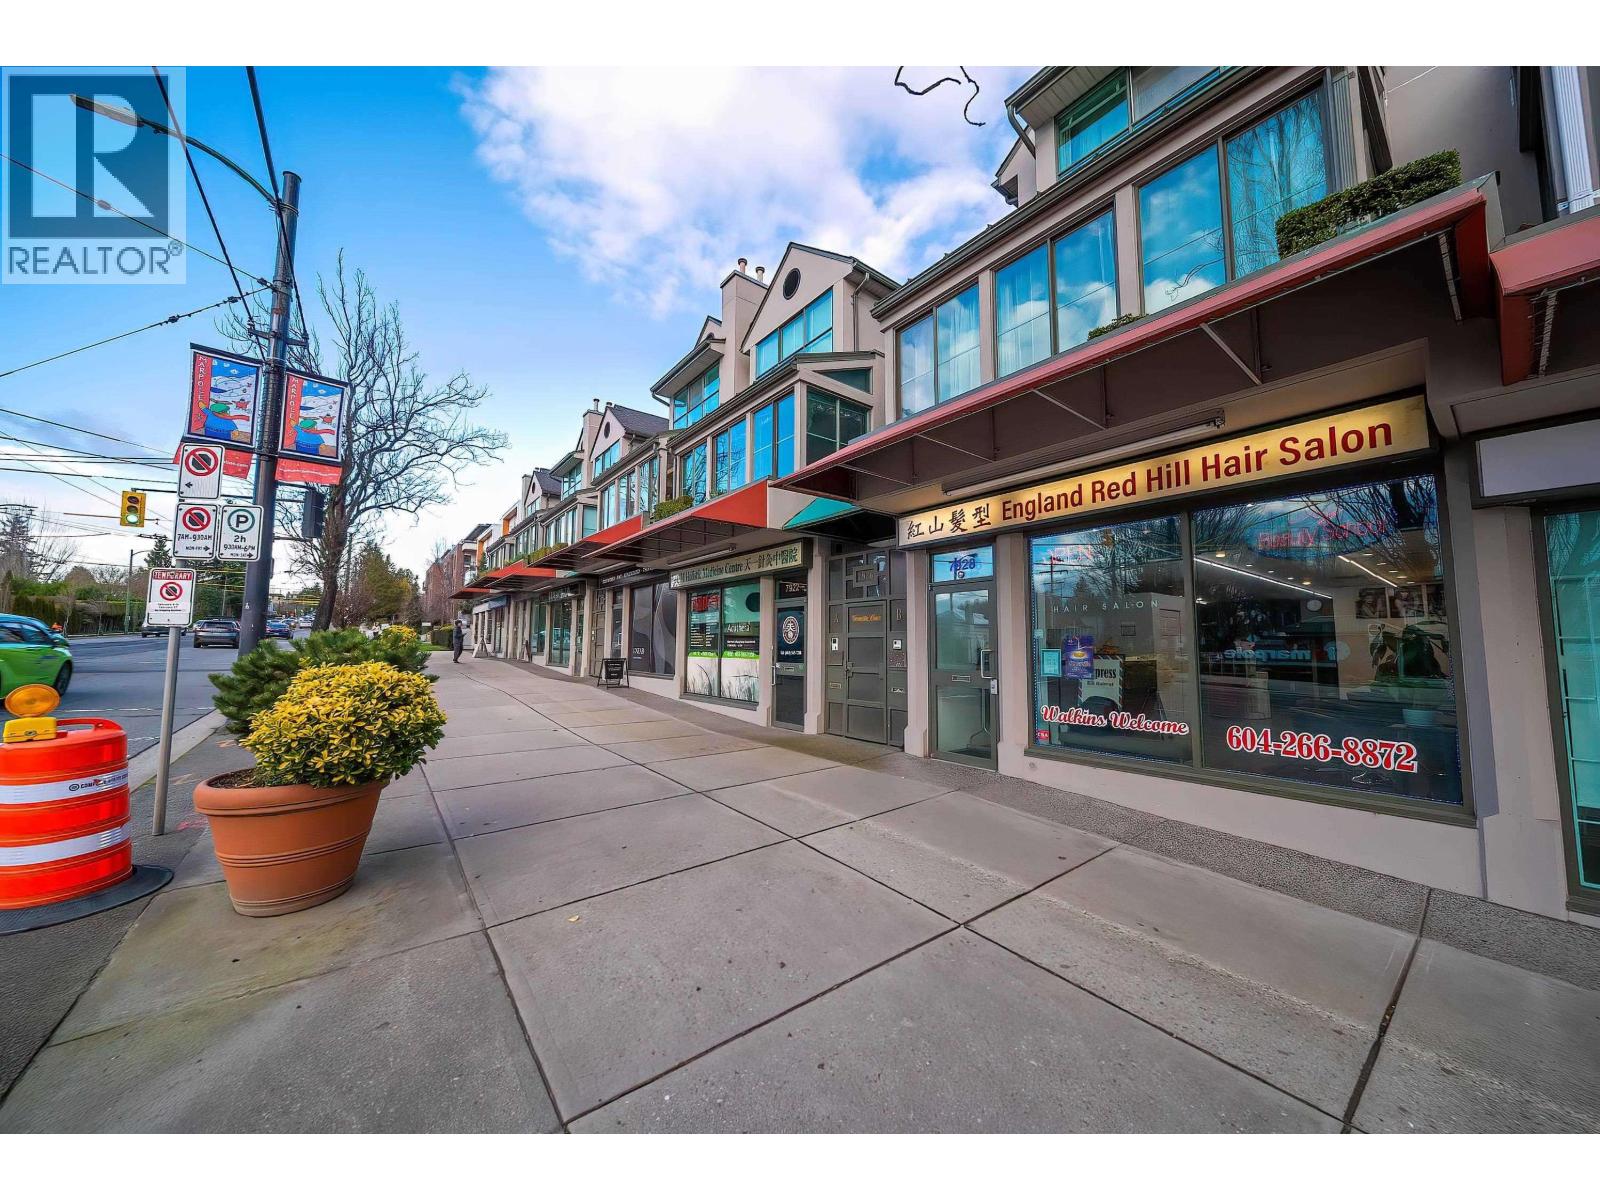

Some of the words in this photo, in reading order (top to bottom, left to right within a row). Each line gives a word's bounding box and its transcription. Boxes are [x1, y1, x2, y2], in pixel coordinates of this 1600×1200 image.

[197, 355, 208, 401] MARPOLE
[289, 376, 299, 419] MARPOLE
[1001, 483, 1083, 521] England
[1091, 472, 1138, 504] Red
[1146, 459, 1191, 493] Hill
[1201, 445, 1268, 482] Hair
[1279, 421, 1393, 466] Salon
[236, 514, 249, 528] P
[907, 503, 992, 540] 紅山髮型
[233, 534, 247, 543] 2h
[154, 571, 192, 580] TEMPORARY
[724, 562, 743, 576] Centre
[1053, 604, 1088, 614] HAIR
[1102, 600, 1159, 611] SALON
[1095, 667, 1117, 680] press
[1040, 704, 1107, 727] Walkins
[1109, 711, 1189, 735] Welcome
[1226, 725, 1418, 773] 604-266-8872
